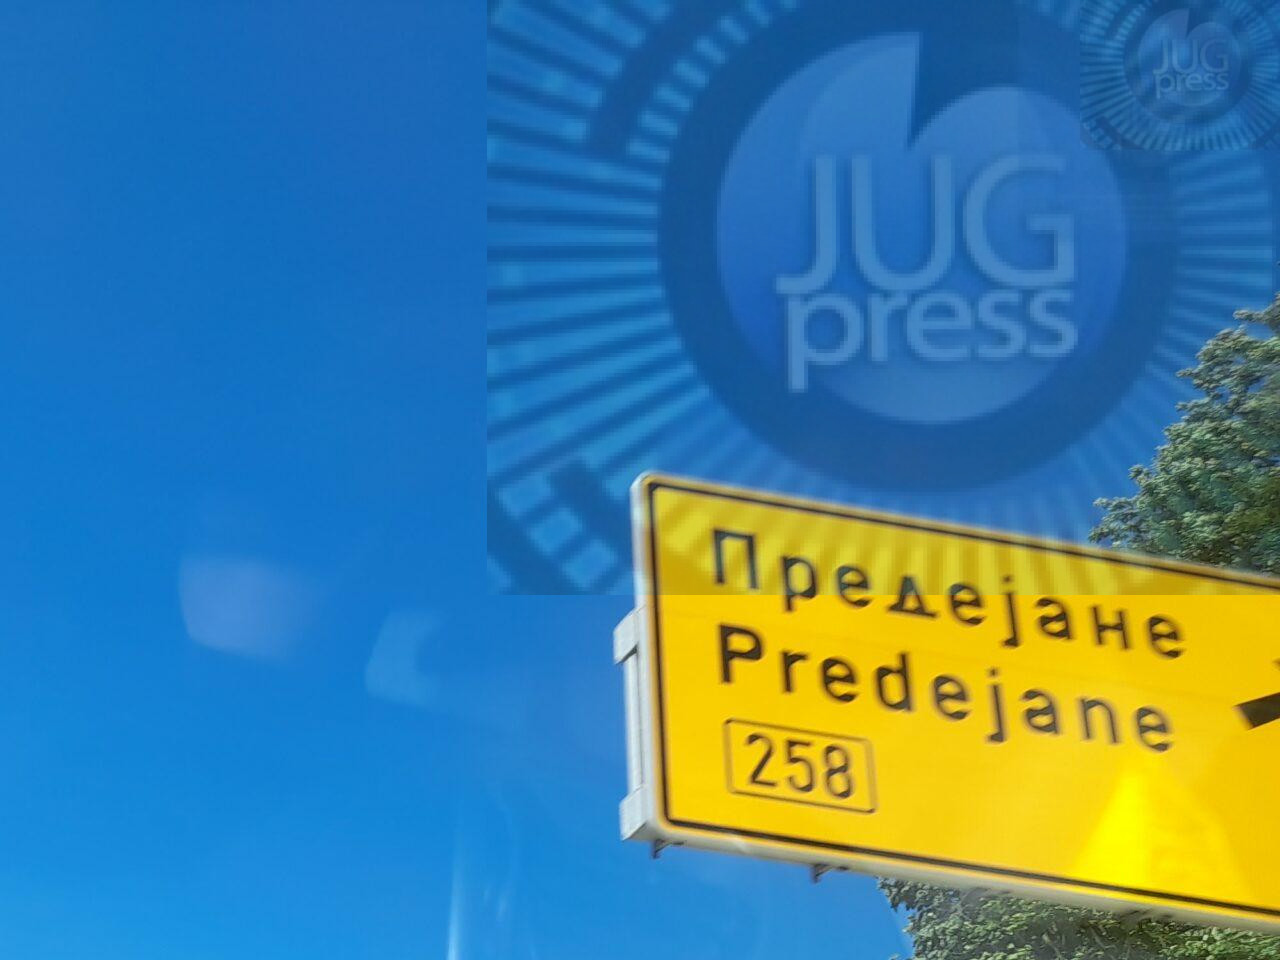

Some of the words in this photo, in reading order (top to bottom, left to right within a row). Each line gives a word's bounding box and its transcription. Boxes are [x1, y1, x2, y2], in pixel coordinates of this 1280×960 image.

[712, 528, 1186, 660] Предејане
[717, 622, 1176, 753] Predejane
[745, 732, 855, 801] 258
